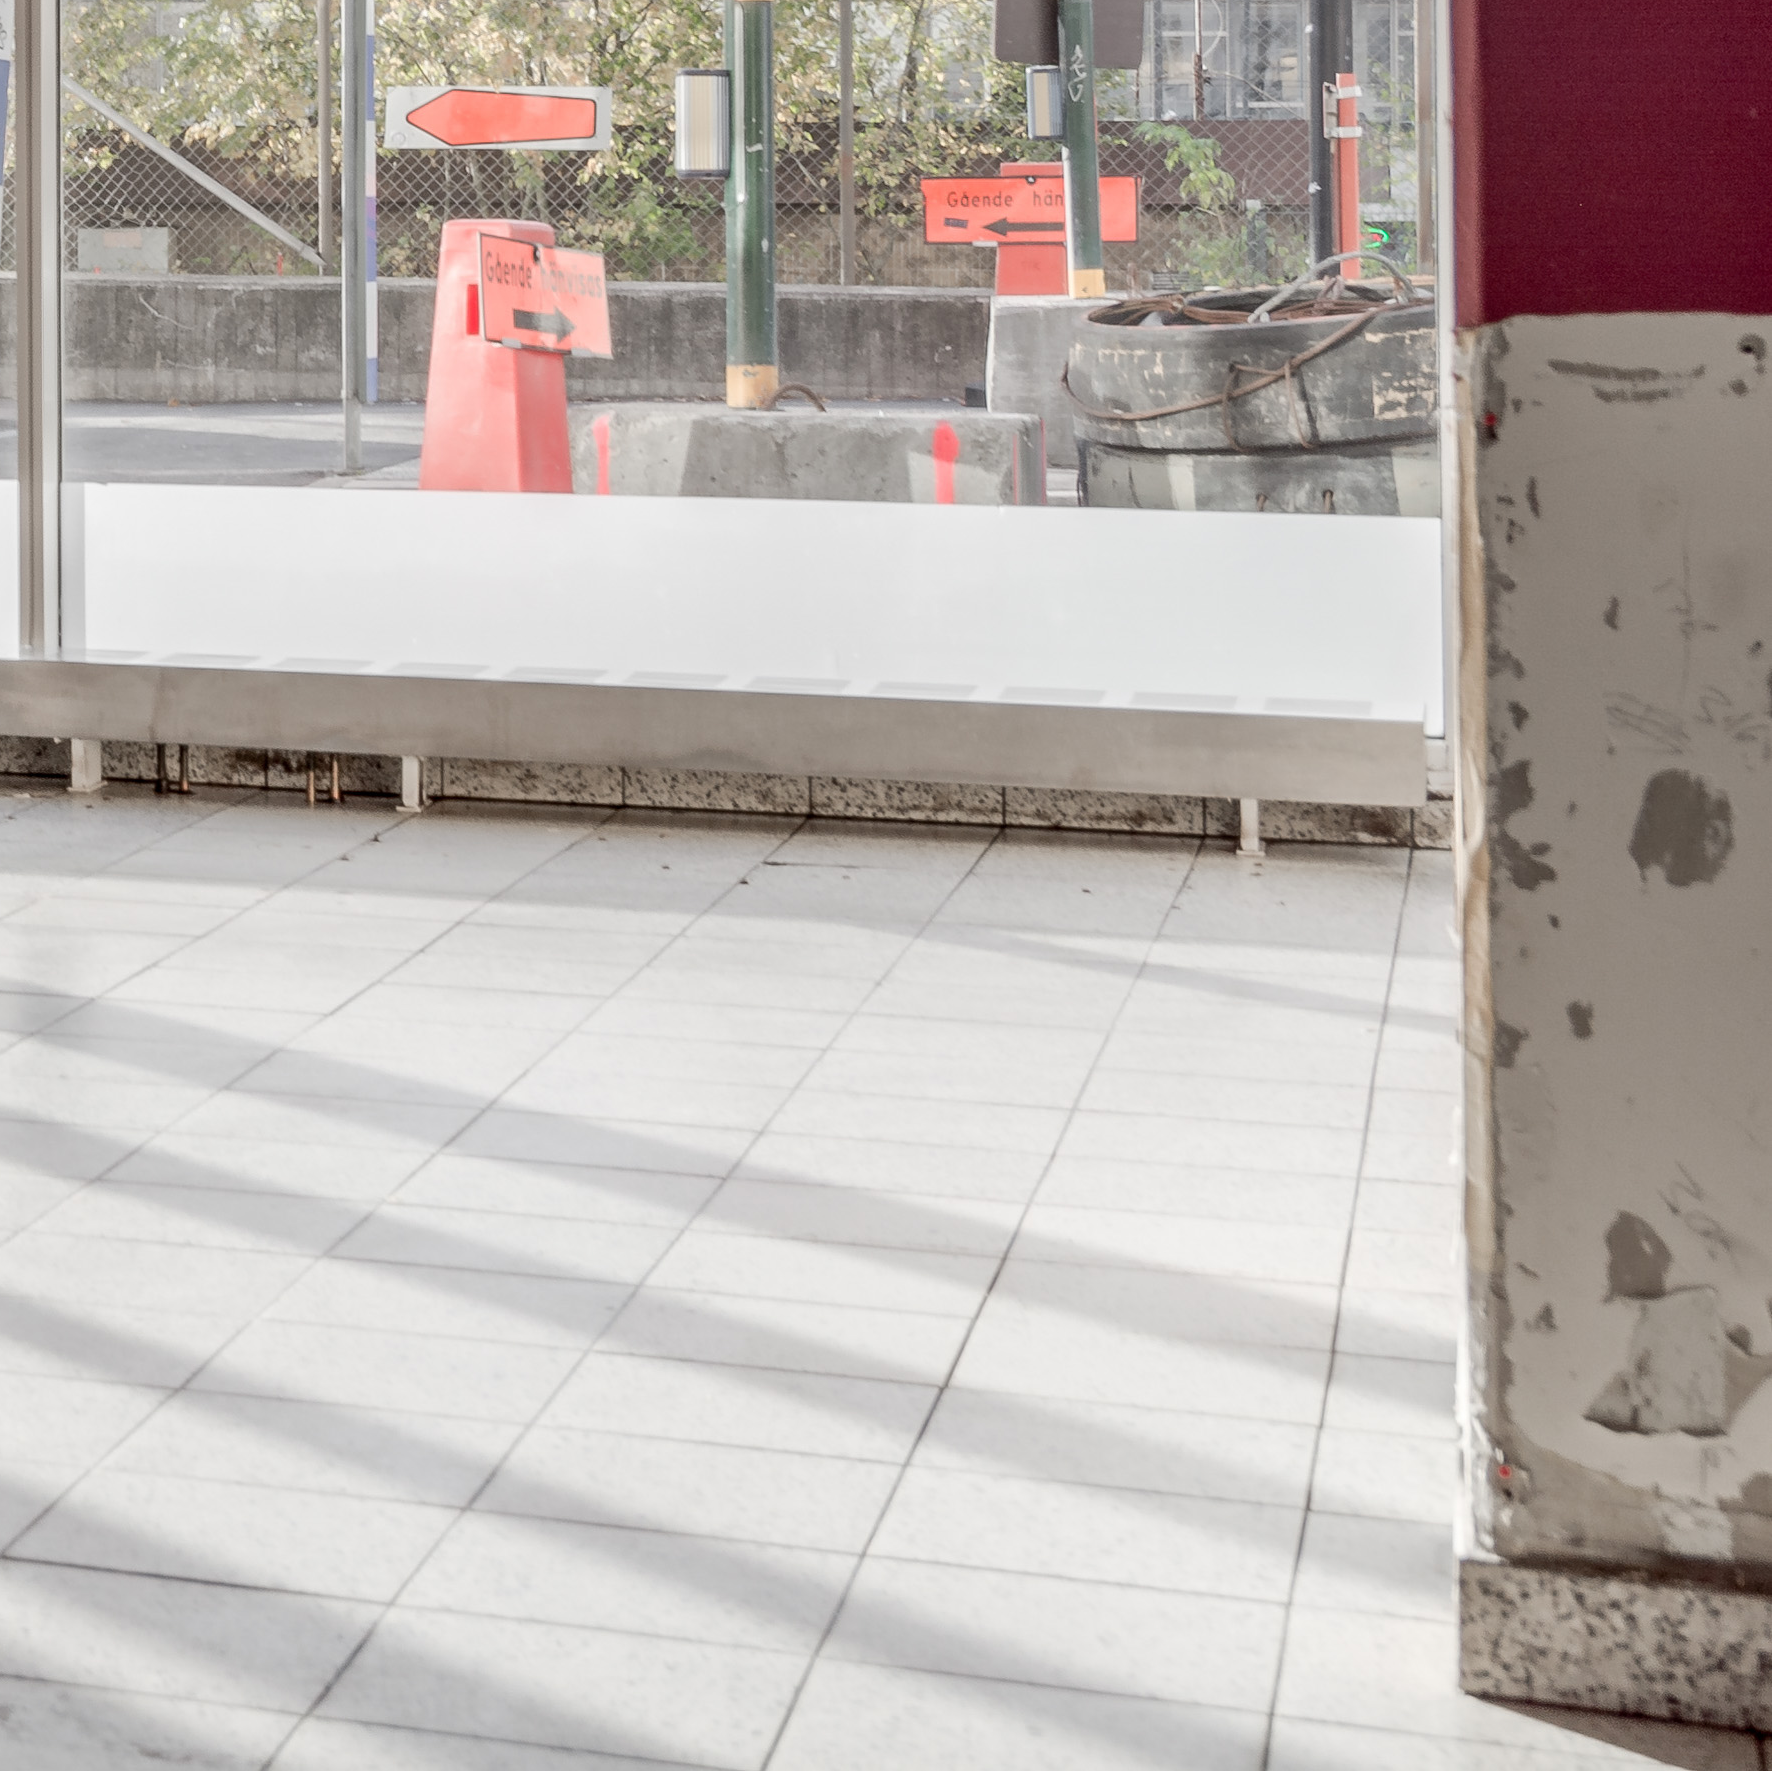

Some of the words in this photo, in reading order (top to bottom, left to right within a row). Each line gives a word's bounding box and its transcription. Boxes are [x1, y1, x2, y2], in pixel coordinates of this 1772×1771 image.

[947, 191, 1014, 208] Gående
[485, 251, 532, 290] Gående
[541, 260, 603, 299] hänvisas
